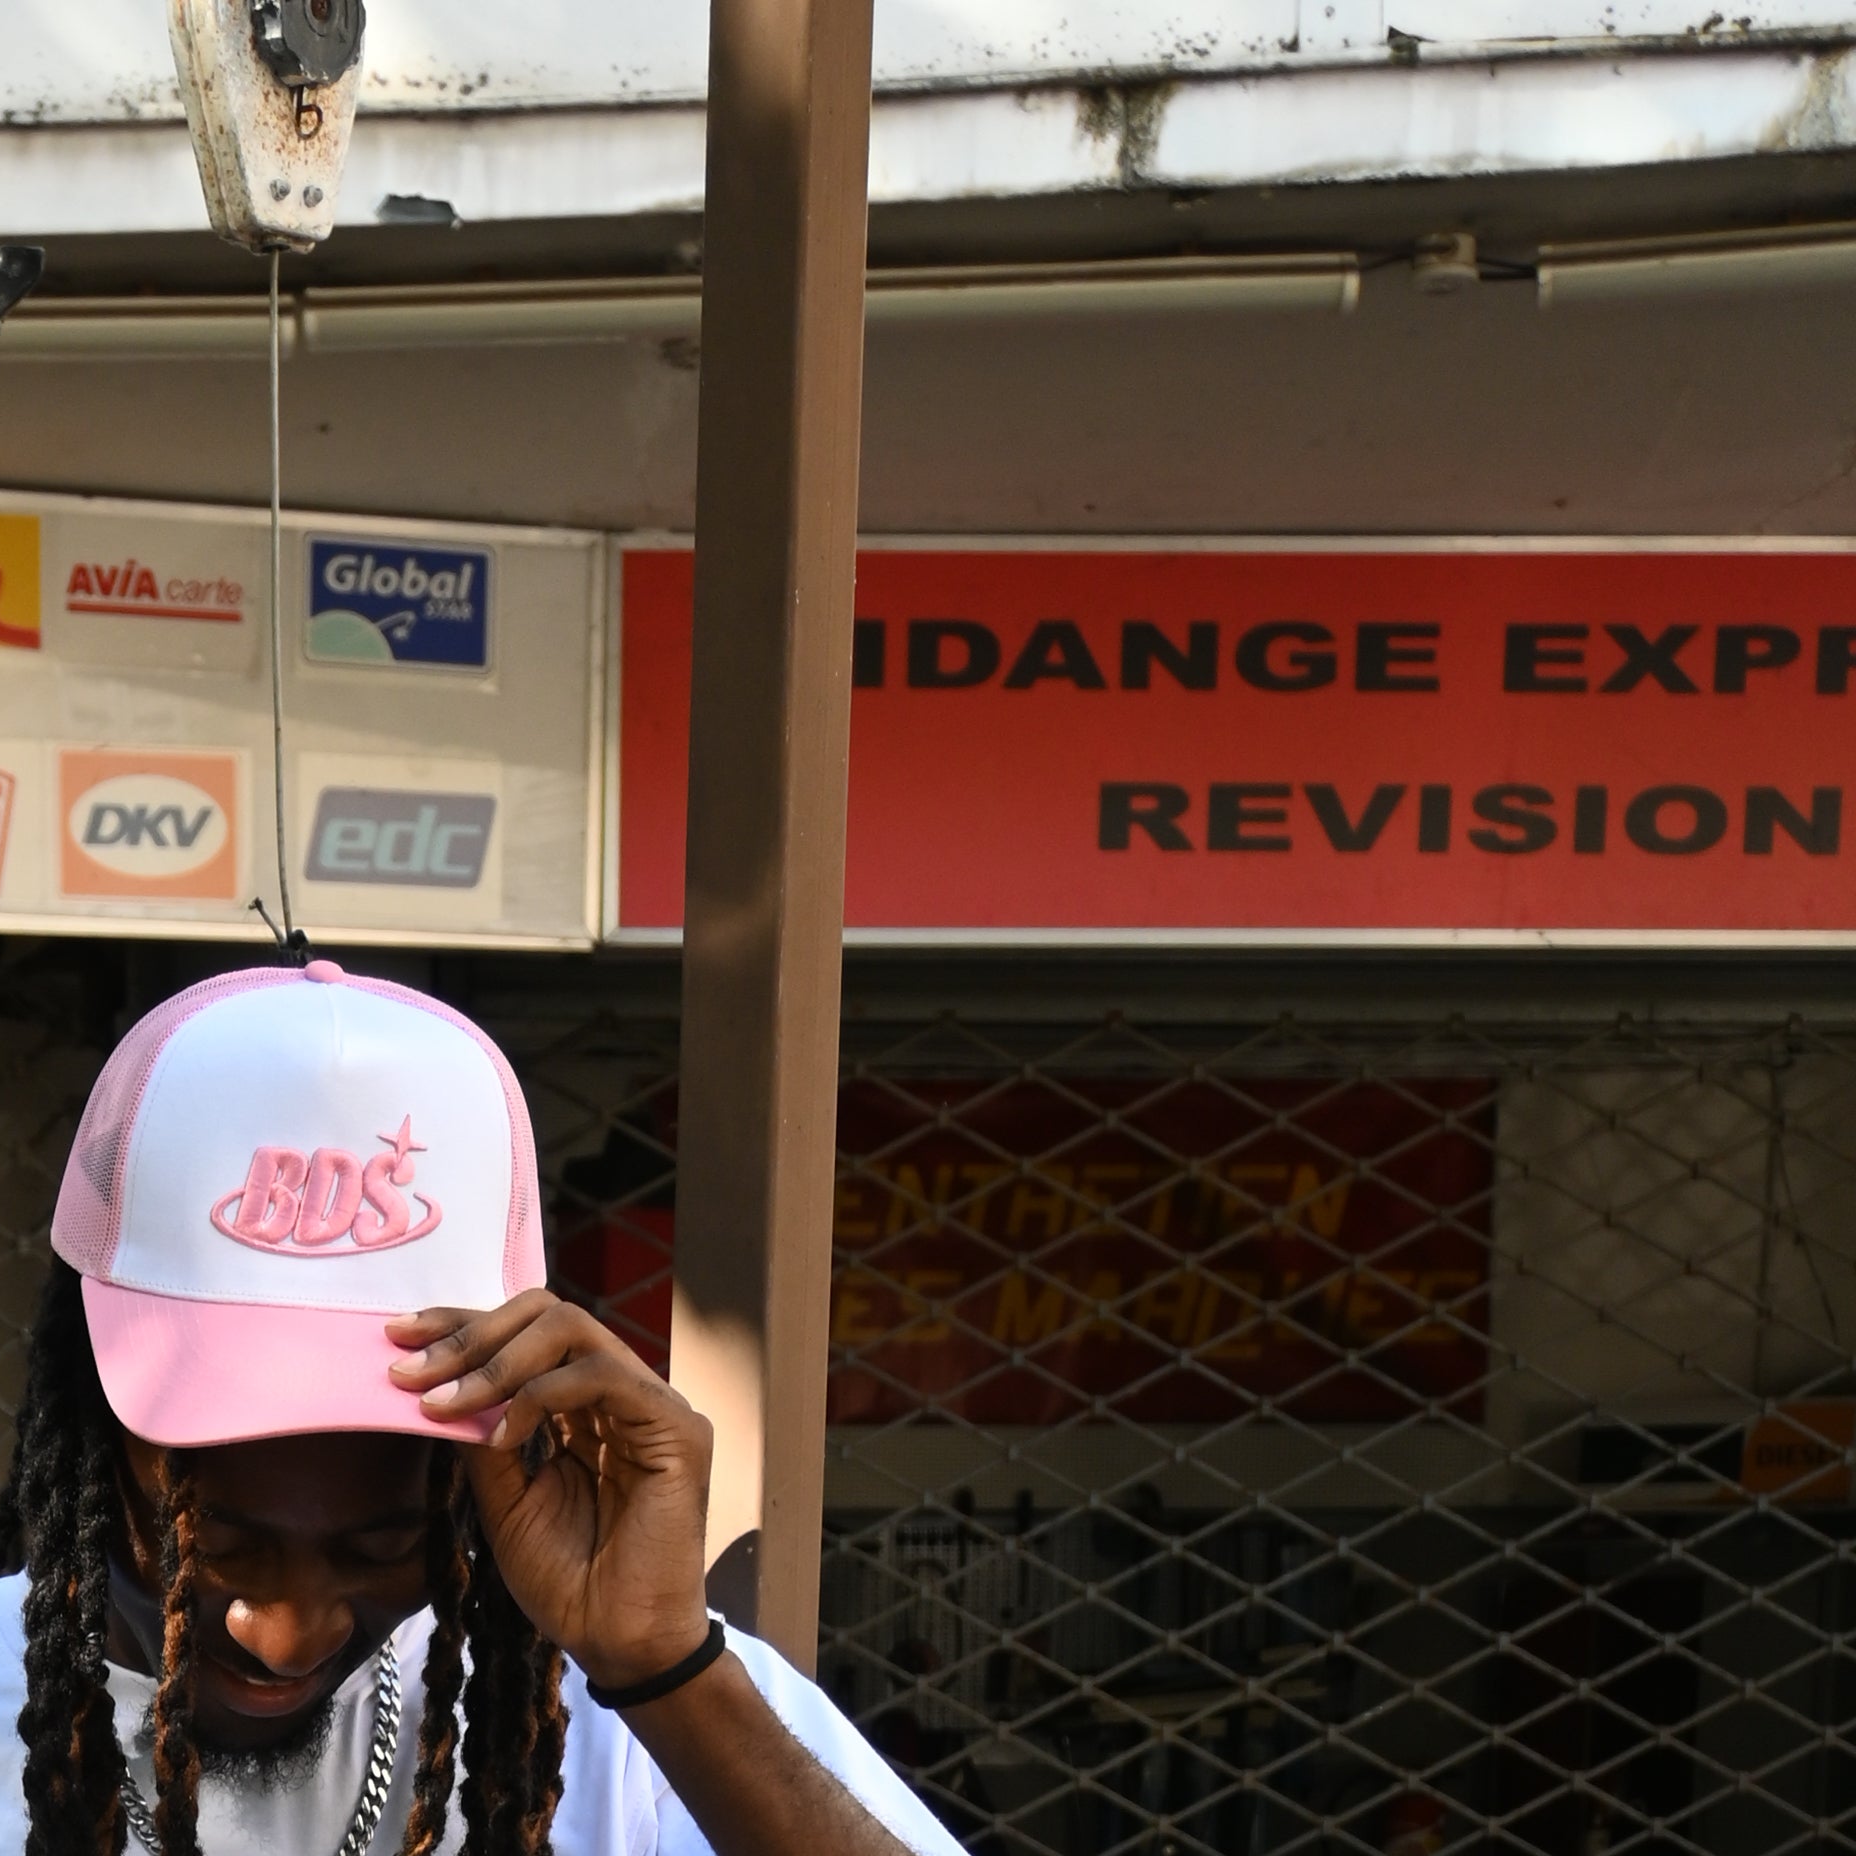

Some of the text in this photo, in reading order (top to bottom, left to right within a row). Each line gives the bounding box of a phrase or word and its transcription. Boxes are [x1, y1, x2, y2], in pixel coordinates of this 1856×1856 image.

[166, 575, 243, 606] carte
[322, 554, 475, 602] Global
[423, 600, 473, 623] STAR
[852, 617, 1443, 694] IDANGE
[81, 801, 216, 849] DKV
[317, 805, 482, 878] edc
[1096, 780, 1844, 857] REVISION
[233, 1145, 416, 1248] BDS
